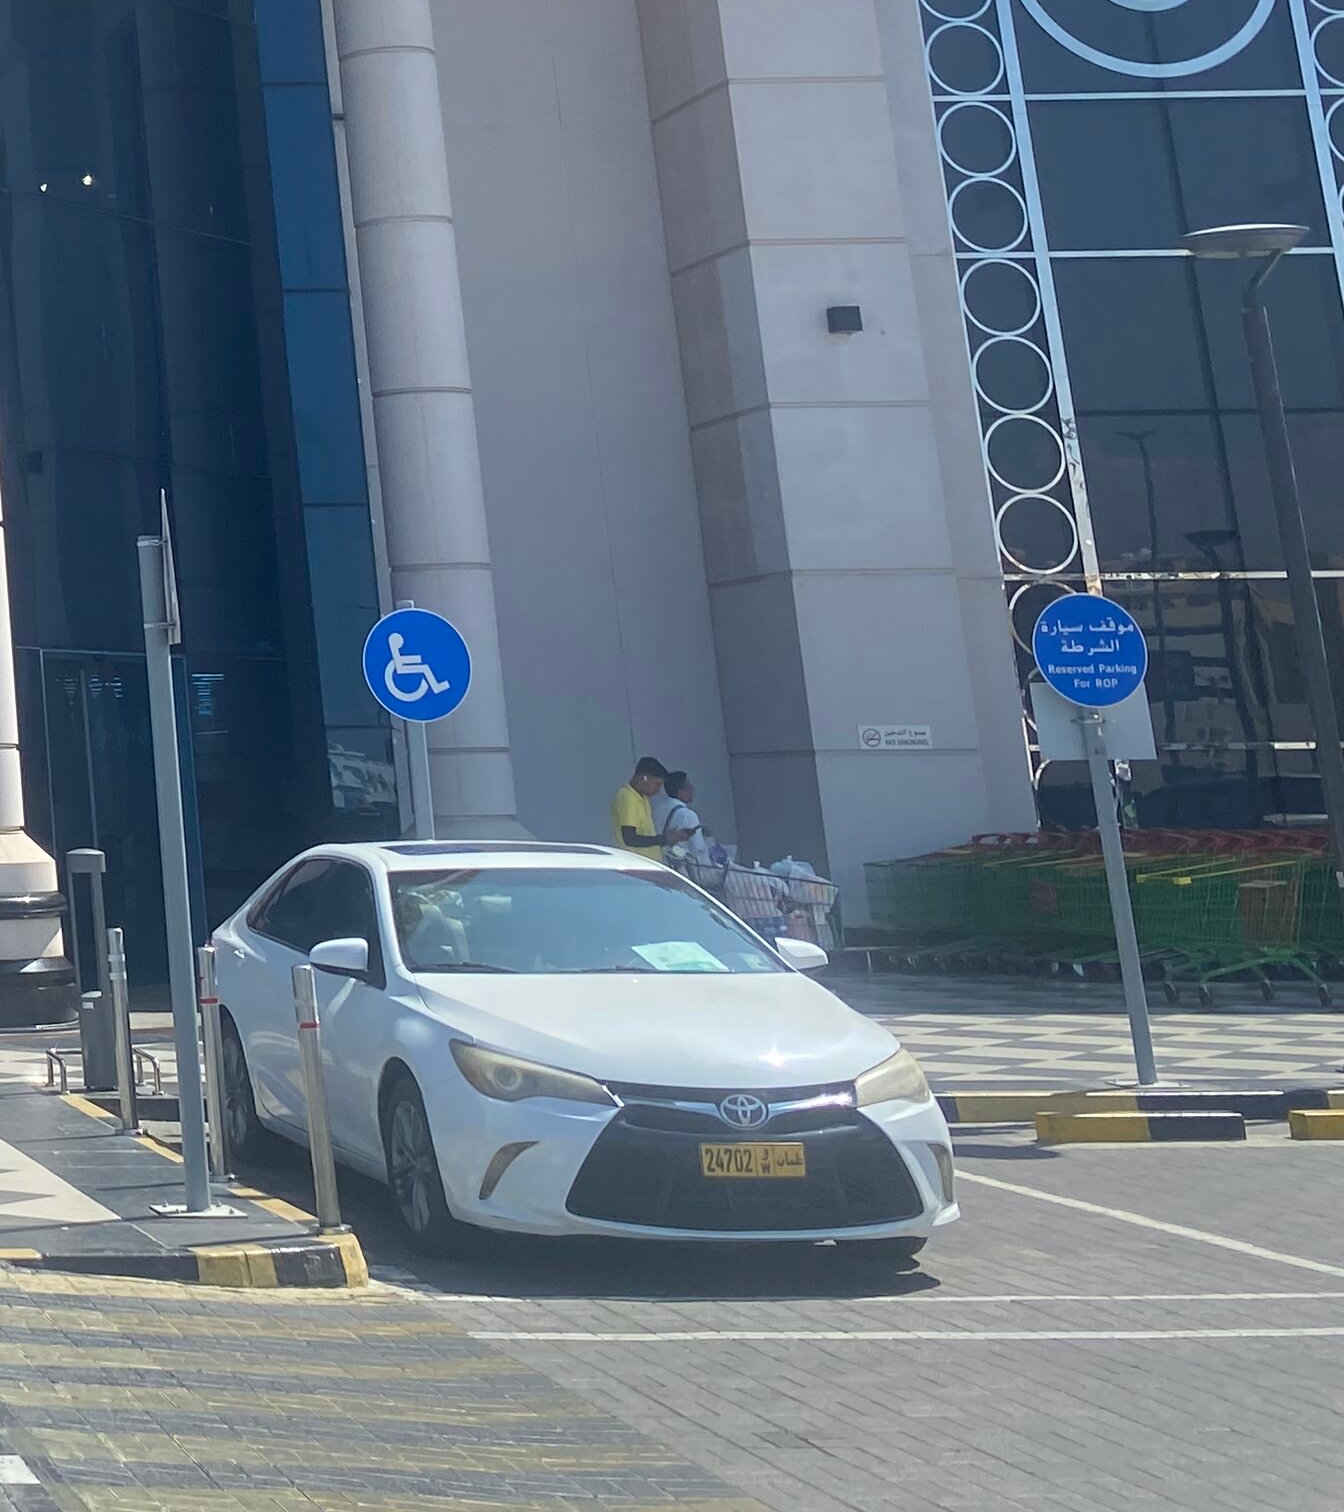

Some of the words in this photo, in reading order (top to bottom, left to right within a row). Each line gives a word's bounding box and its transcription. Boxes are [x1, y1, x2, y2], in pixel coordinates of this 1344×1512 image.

[1040, 619, 1083, 636] سيارة
[1089, 617, 1134, 635] موقف
[1061, 639, 1120, 656] الشرطة
[1048, 664, 1094, 674] Reserved
[1099, 664, 1137, 675] Parking
[1074, 678, 1091, 688] For
[1096, 678, 1118, 688] ROP
[705, 1148, 753, 1173] 24702
[761, 1162, 771, 1174] W
